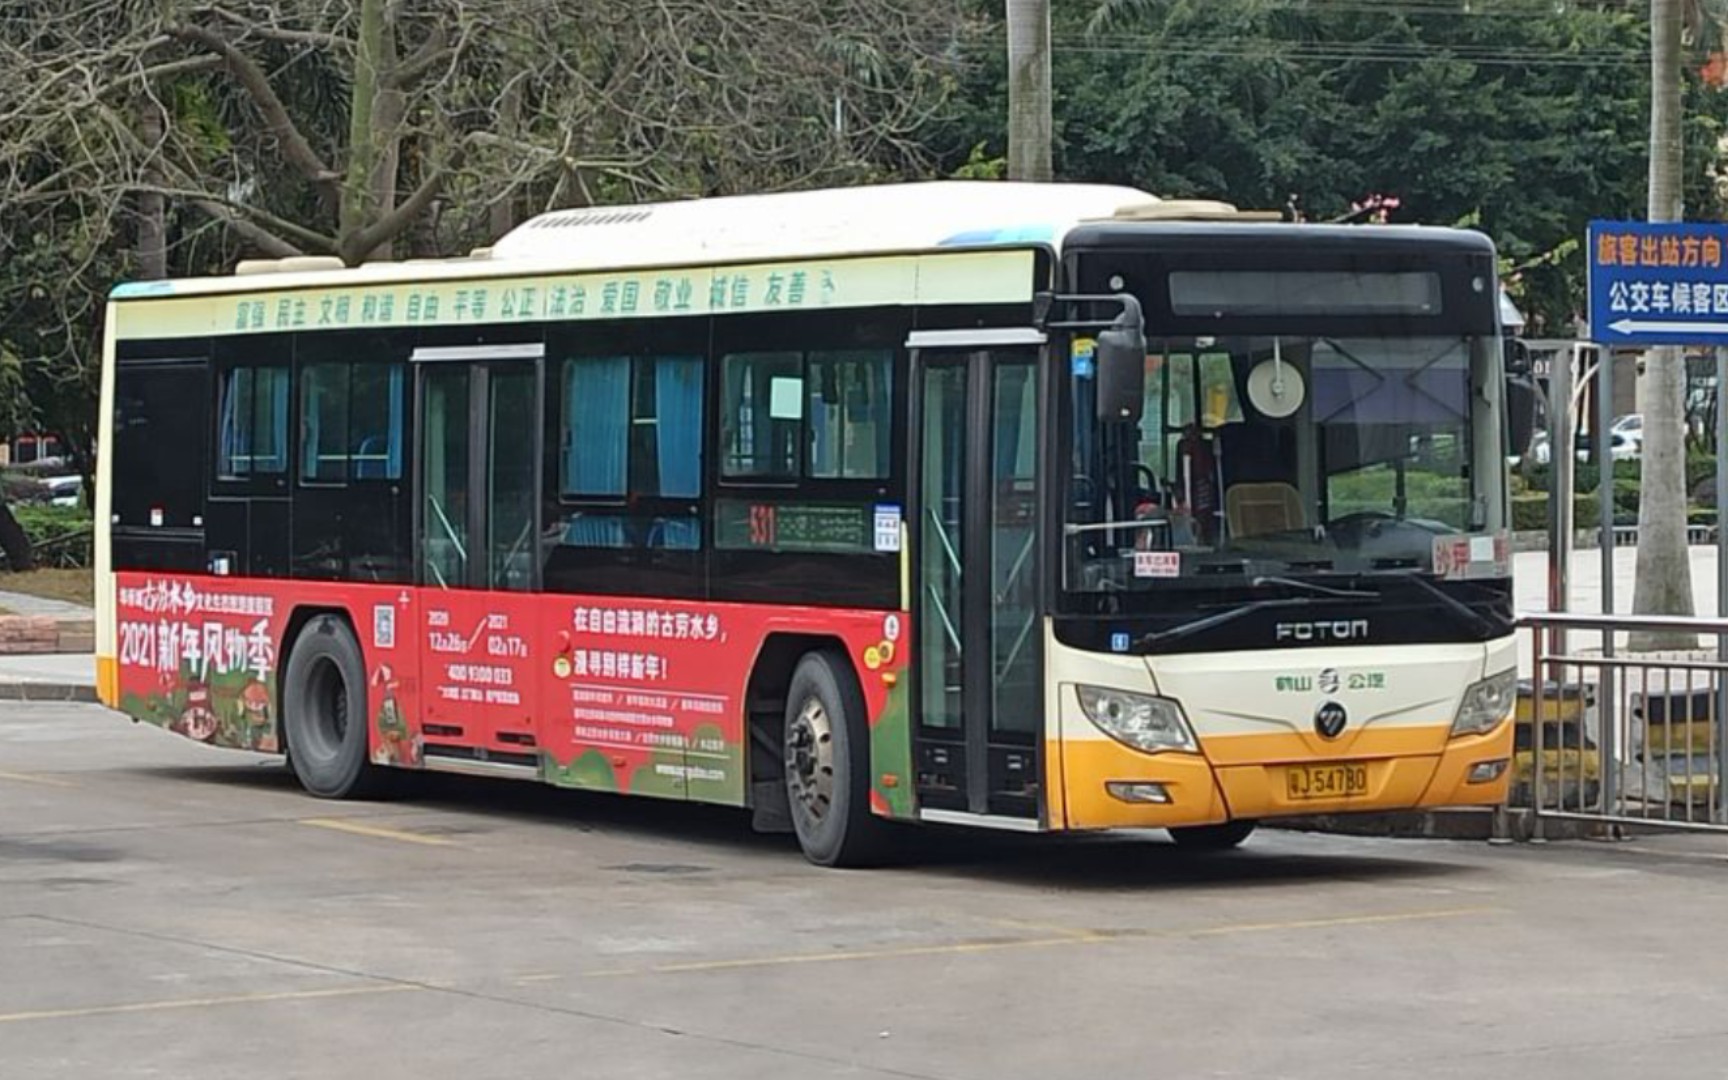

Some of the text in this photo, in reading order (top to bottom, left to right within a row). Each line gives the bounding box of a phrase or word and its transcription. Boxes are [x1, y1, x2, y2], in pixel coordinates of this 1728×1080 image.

[1598, 234, 1721, 267] 旅客出站方向
[235, 302, 265, 330] 富强
[276, 300, 305, 327] 民主
[318, 296, 350, 324] 文明
[362, 293, 393, 323] 和谐
[406, 291, 439, 321] 自由
[453, 289, 487, 319] 平等
[501, 287, 536, 316] 公正
[550, 284, 588, 315] 法治
[600, 281, 640, 313] 爱国
[654, 278, 692, 310] 敬业
[710, 275, 749, 308] 诚信
[764, 272, 807, 304] 友善
[1609, 281, 1728, 313] 公交车候客区
[1276, 620, 1368, 640] FOTON
[120, 618, 273, 683] 2021新年风物季
